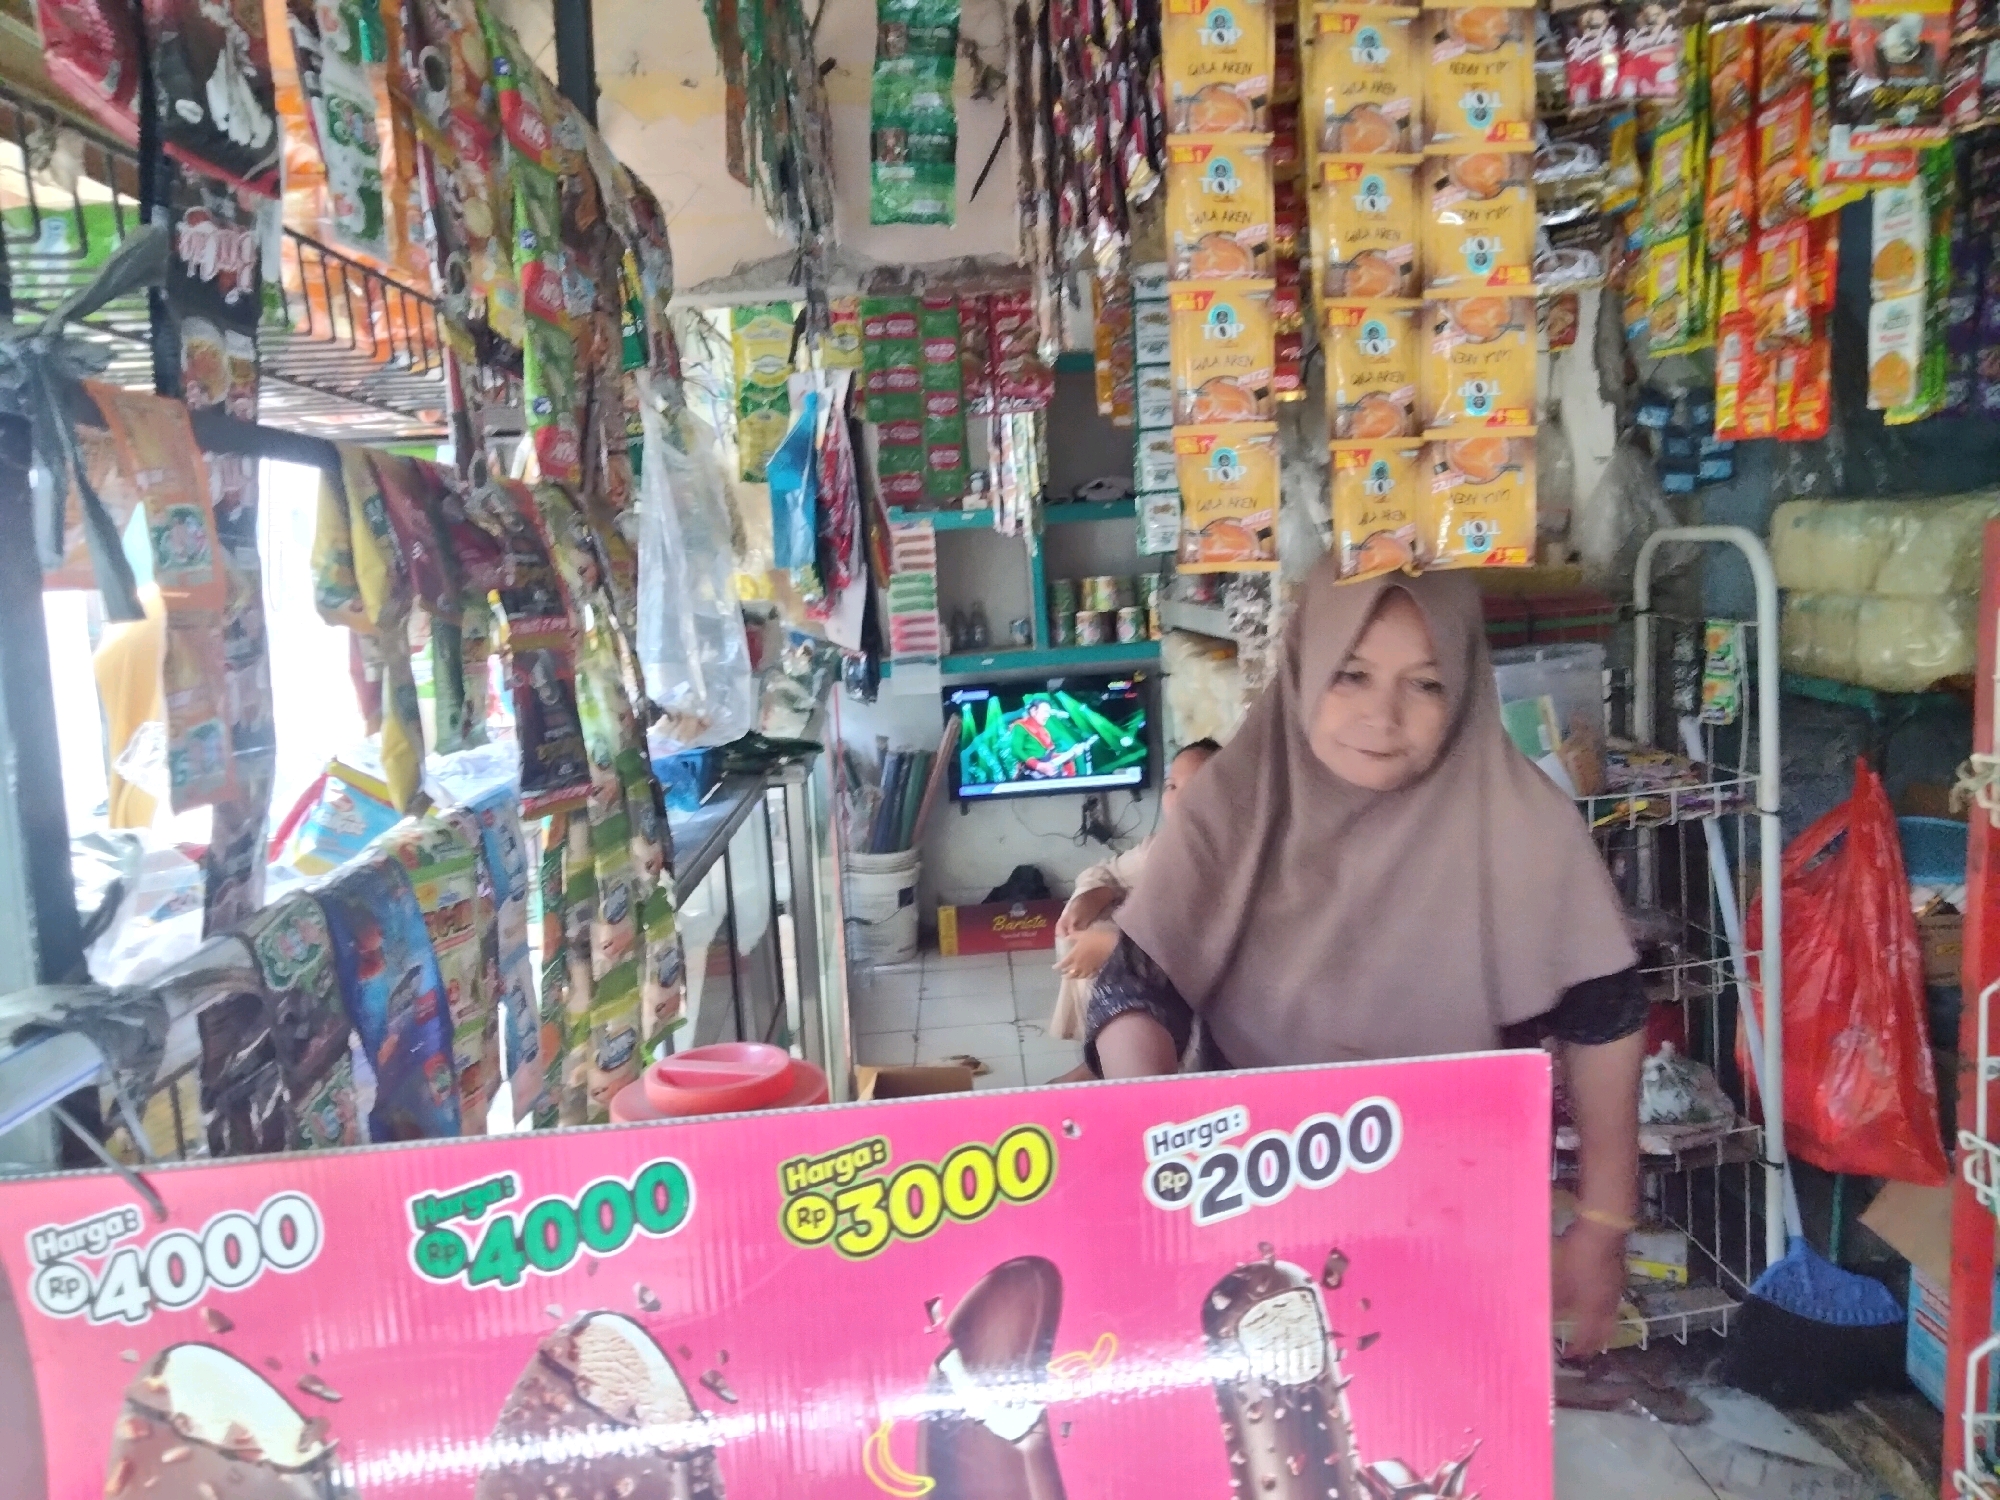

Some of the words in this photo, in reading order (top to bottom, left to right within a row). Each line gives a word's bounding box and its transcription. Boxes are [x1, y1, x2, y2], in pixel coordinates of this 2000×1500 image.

[1196, 28, 1243, 45] TOP
[1198, 177, 1242, 194] TOP
[1201, 323, 1245, 340] TOP
[1356, 339, 1397, 355] TOP
[1203, 465, 1247, 482] TOP
[1362, 479, 1396, 495] TOP
[992, 914, 1048, 931] Barista
[1152, 1112, 1243, 1156] Harga:
[784, 1139, 888, 1194] Harga:
[1157, 1170, 1190, 1195] Rp
[1198, 1104, 1393, 1218] 2000
[412, 1175, 516, 1229] Harga:
[794, 1205, 826, 1230] Rp
[836, 1126, 1053, 1258] 3000
[32, 1207, 140, 1262] Harga:
[426, 1242, 458, 1264] Rp
[467, 1161, 690, 1287] 4000
[48, 1274, 82, 1301] Rp
[91, 1194, 319, 1323] 4000
